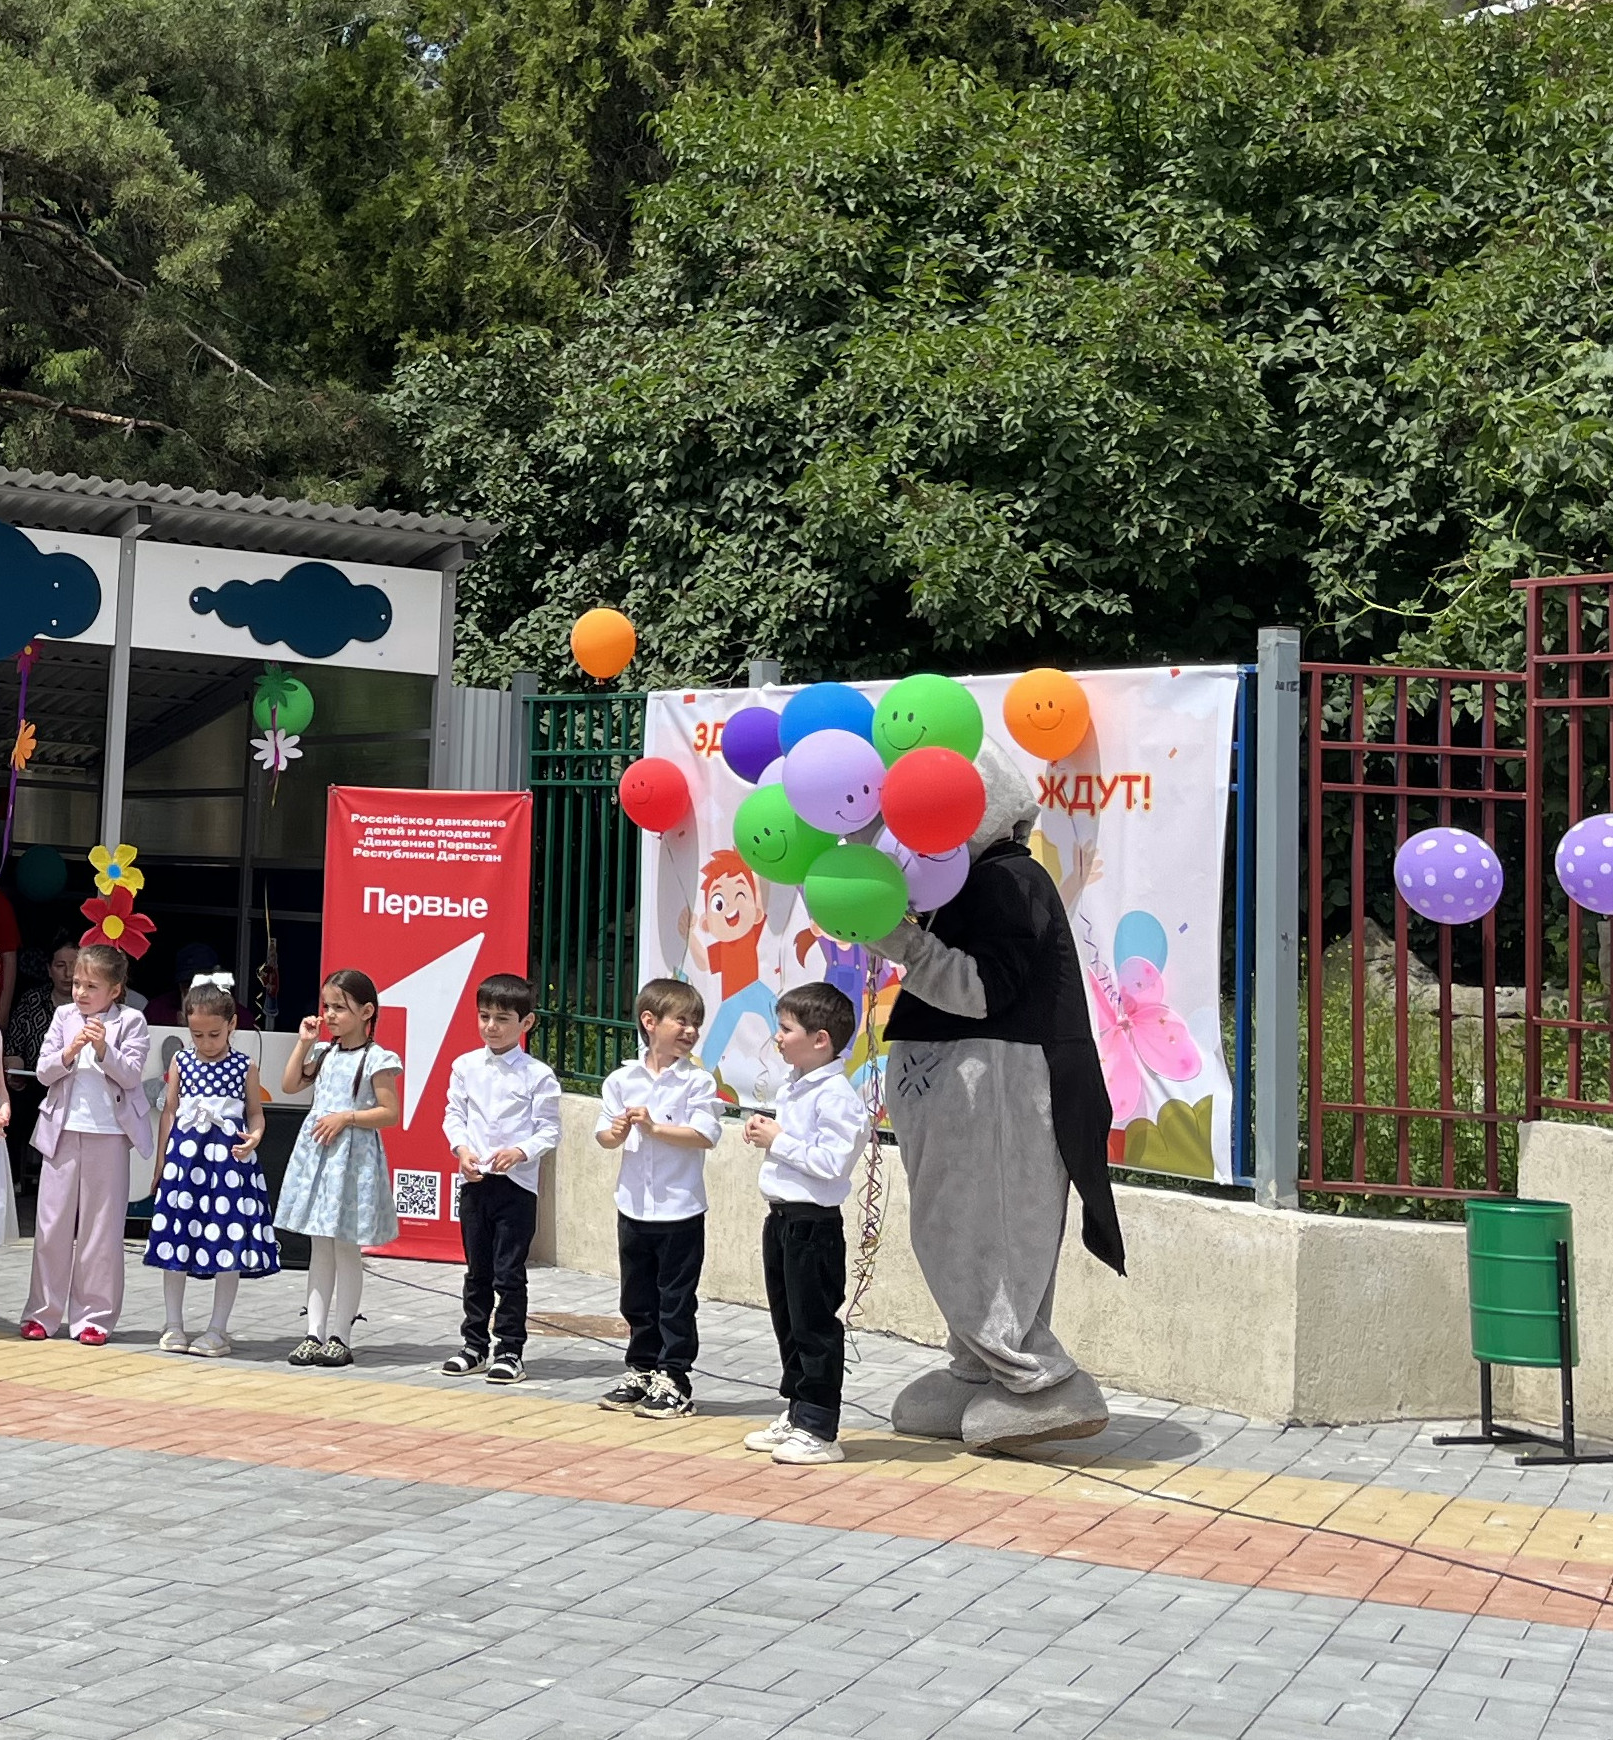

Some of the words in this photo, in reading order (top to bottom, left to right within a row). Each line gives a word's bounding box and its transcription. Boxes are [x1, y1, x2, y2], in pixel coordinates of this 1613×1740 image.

[1037, 775, 1151, 816] ЖДУТ!
[351, 813, 434, 826] Российское
[435, 818, 507, 828] движение
[364, 826, 405, 836] детей
[407, 828, 416, 836] и
[418, 828, 491, 840] молодежи
[357, 837, 435, 848] «Движение
[437, 839, 498, 851] Первых»
[353, 848, 435, 860] Республики
[436, 851, 502, 862] Дагестан
[363, 886, 489, 924] Первые
